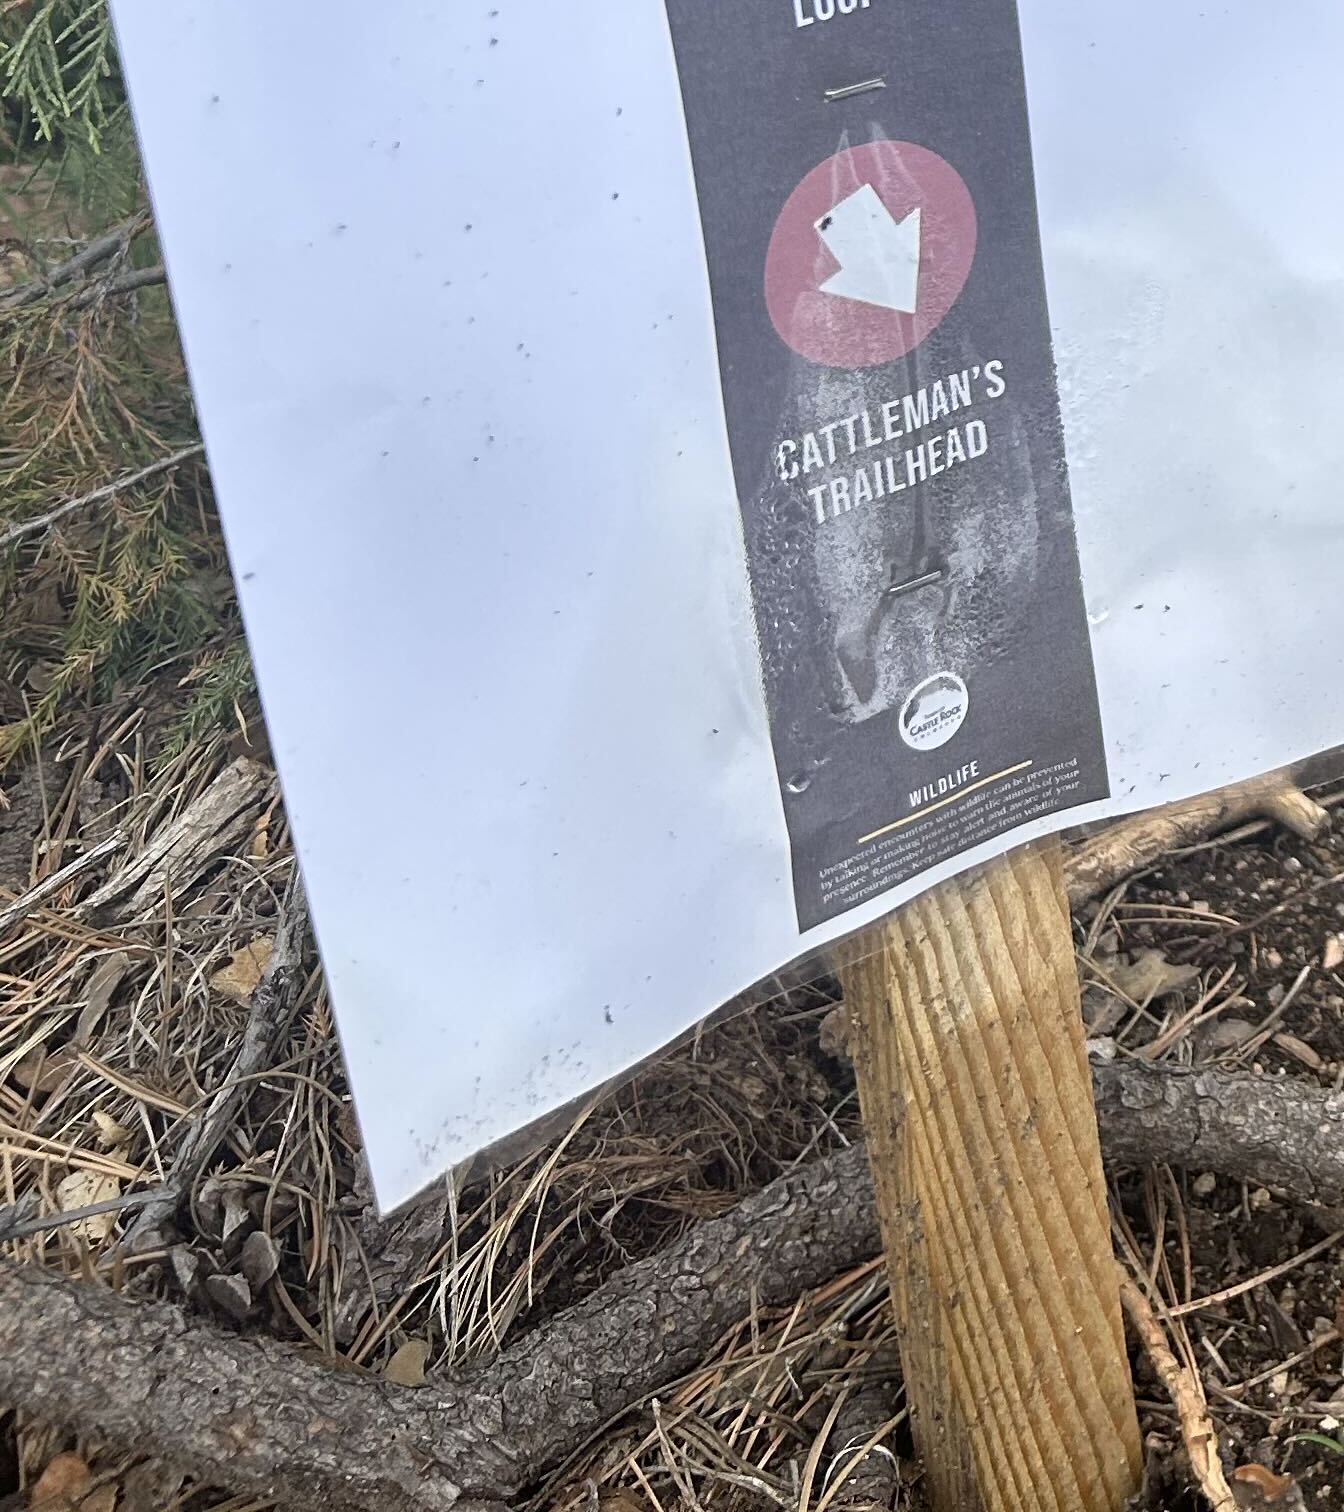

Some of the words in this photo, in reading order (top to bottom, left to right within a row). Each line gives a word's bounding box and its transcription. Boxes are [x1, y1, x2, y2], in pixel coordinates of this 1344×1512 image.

[775, 359, 1006, 480] CATTLEMAN'S
[807, 419, 989, 525] TRAILHEAD
[819, 844, 877, 878] Unexpected
[993, 782, 1011, 795] can
[1027, 758, 1078, 782] prevented
[908, 760, 980, 807] WILDLIFE
